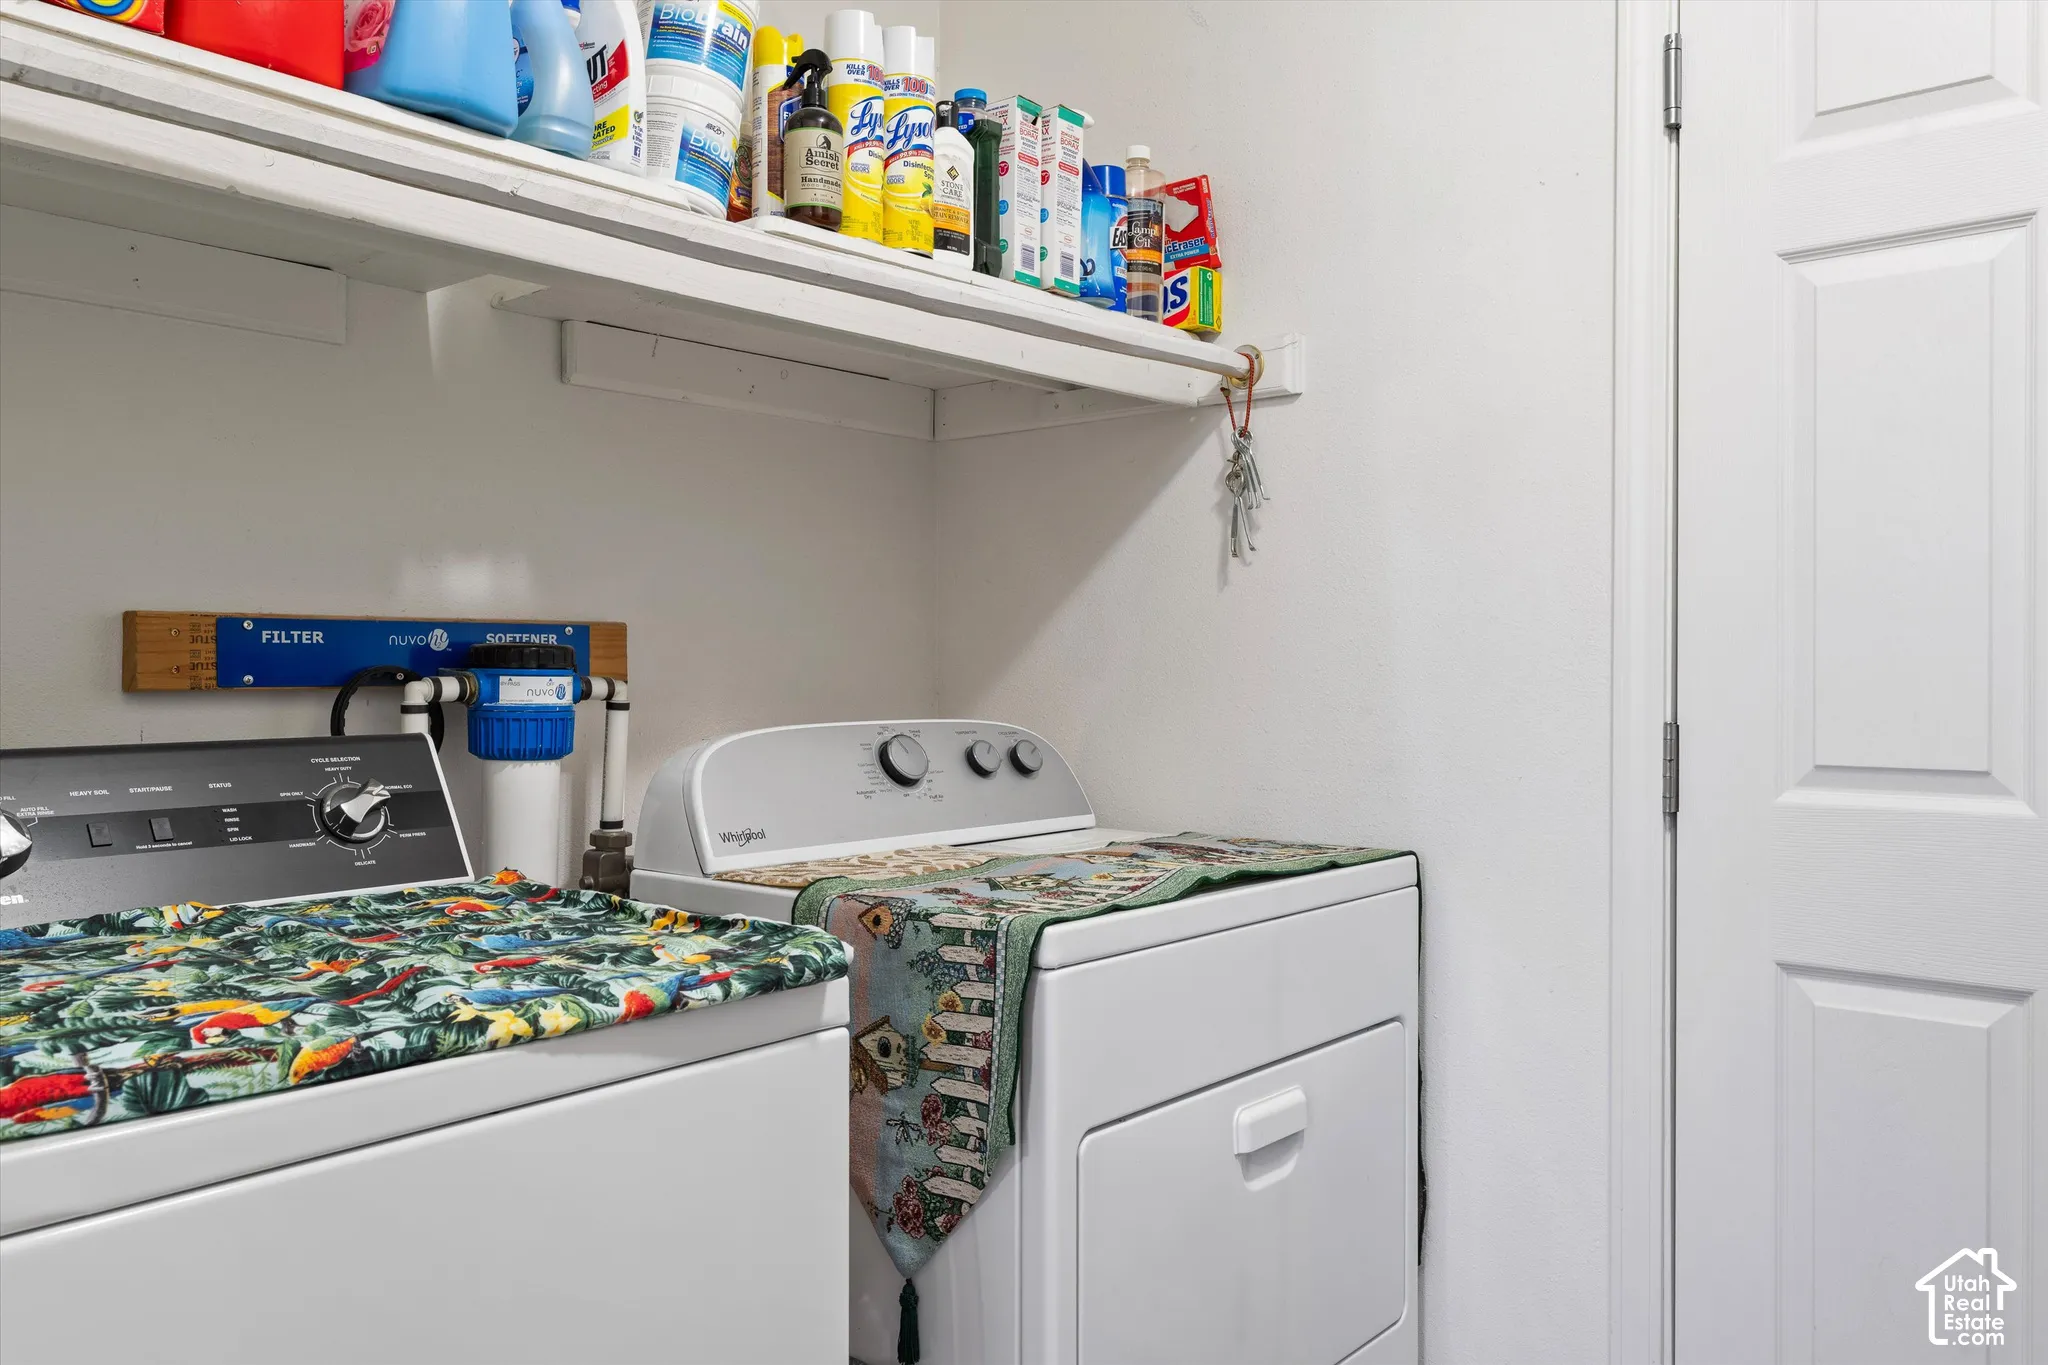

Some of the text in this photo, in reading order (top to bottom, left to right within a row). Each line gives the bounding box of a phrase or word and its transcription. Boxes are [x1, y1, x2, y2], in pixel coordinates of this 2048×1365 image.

[902, 76, 929, 95] 100
[886, 112, 935, 150] Lysol
[1020, 127, 1039, 142] BORAX
[1061, 137, 1080, 152] BORAX
[805, 148, 840, 162] Amish
[805, 157, 839, 171] Secret
[801, 176, 842, 189] Handmade
[941, 180, 964, 191] STONE
[942, 187, 963, 198] CARE
[1128, 221, 1157, 236] Lamp
[1134, 235, 1151, 248] Oil
[262, 631, 324, 644] FILTER
[389, 633, 426, 646] nuvo
[486, 633, 558, 645] SOFTENER
[526, 688, 554, 697] nuvo
[129, 786, 173, 794] START/PAUSE
[718, 827, 766, 848] Whirlpool
